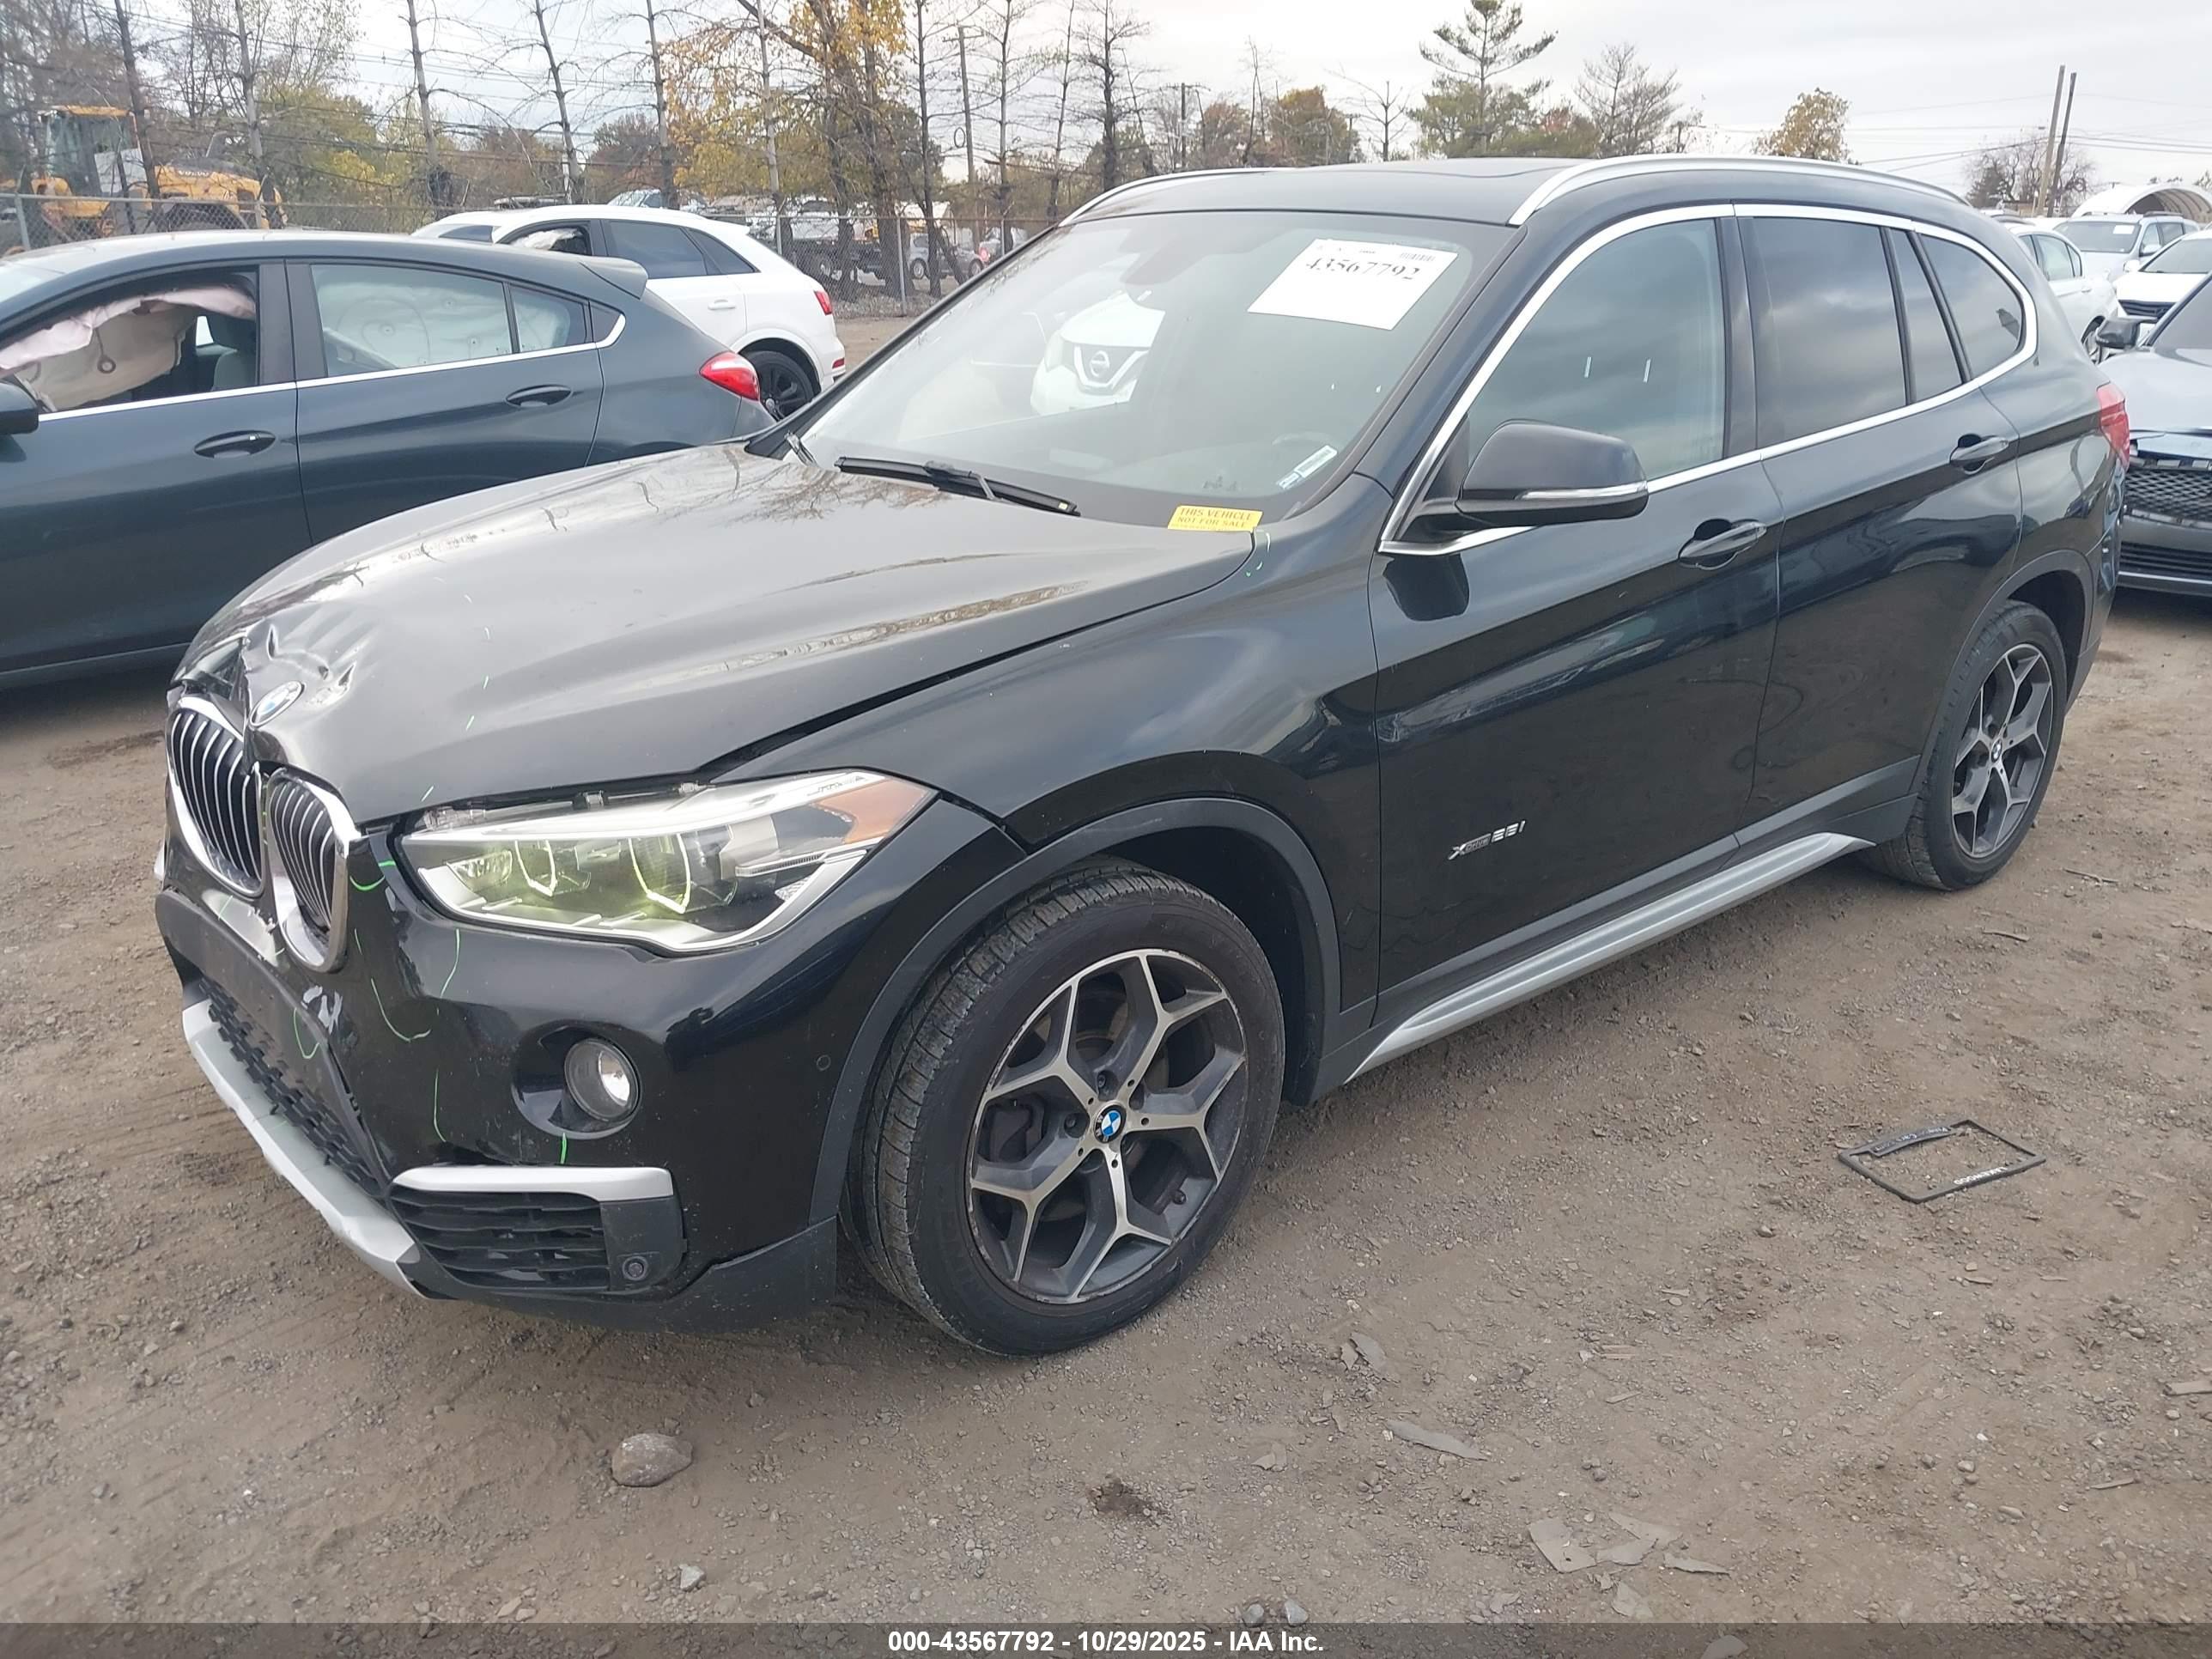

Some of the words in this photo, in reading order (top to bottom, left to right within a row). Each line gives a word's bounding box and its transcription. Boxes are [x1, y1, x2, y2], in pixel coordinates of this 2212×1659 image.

[1305, 257, 1421, 281] 43567792
[1180, 507, 1203, 516] THIS
[1207, 508, 1252, 520] VEHICLE
